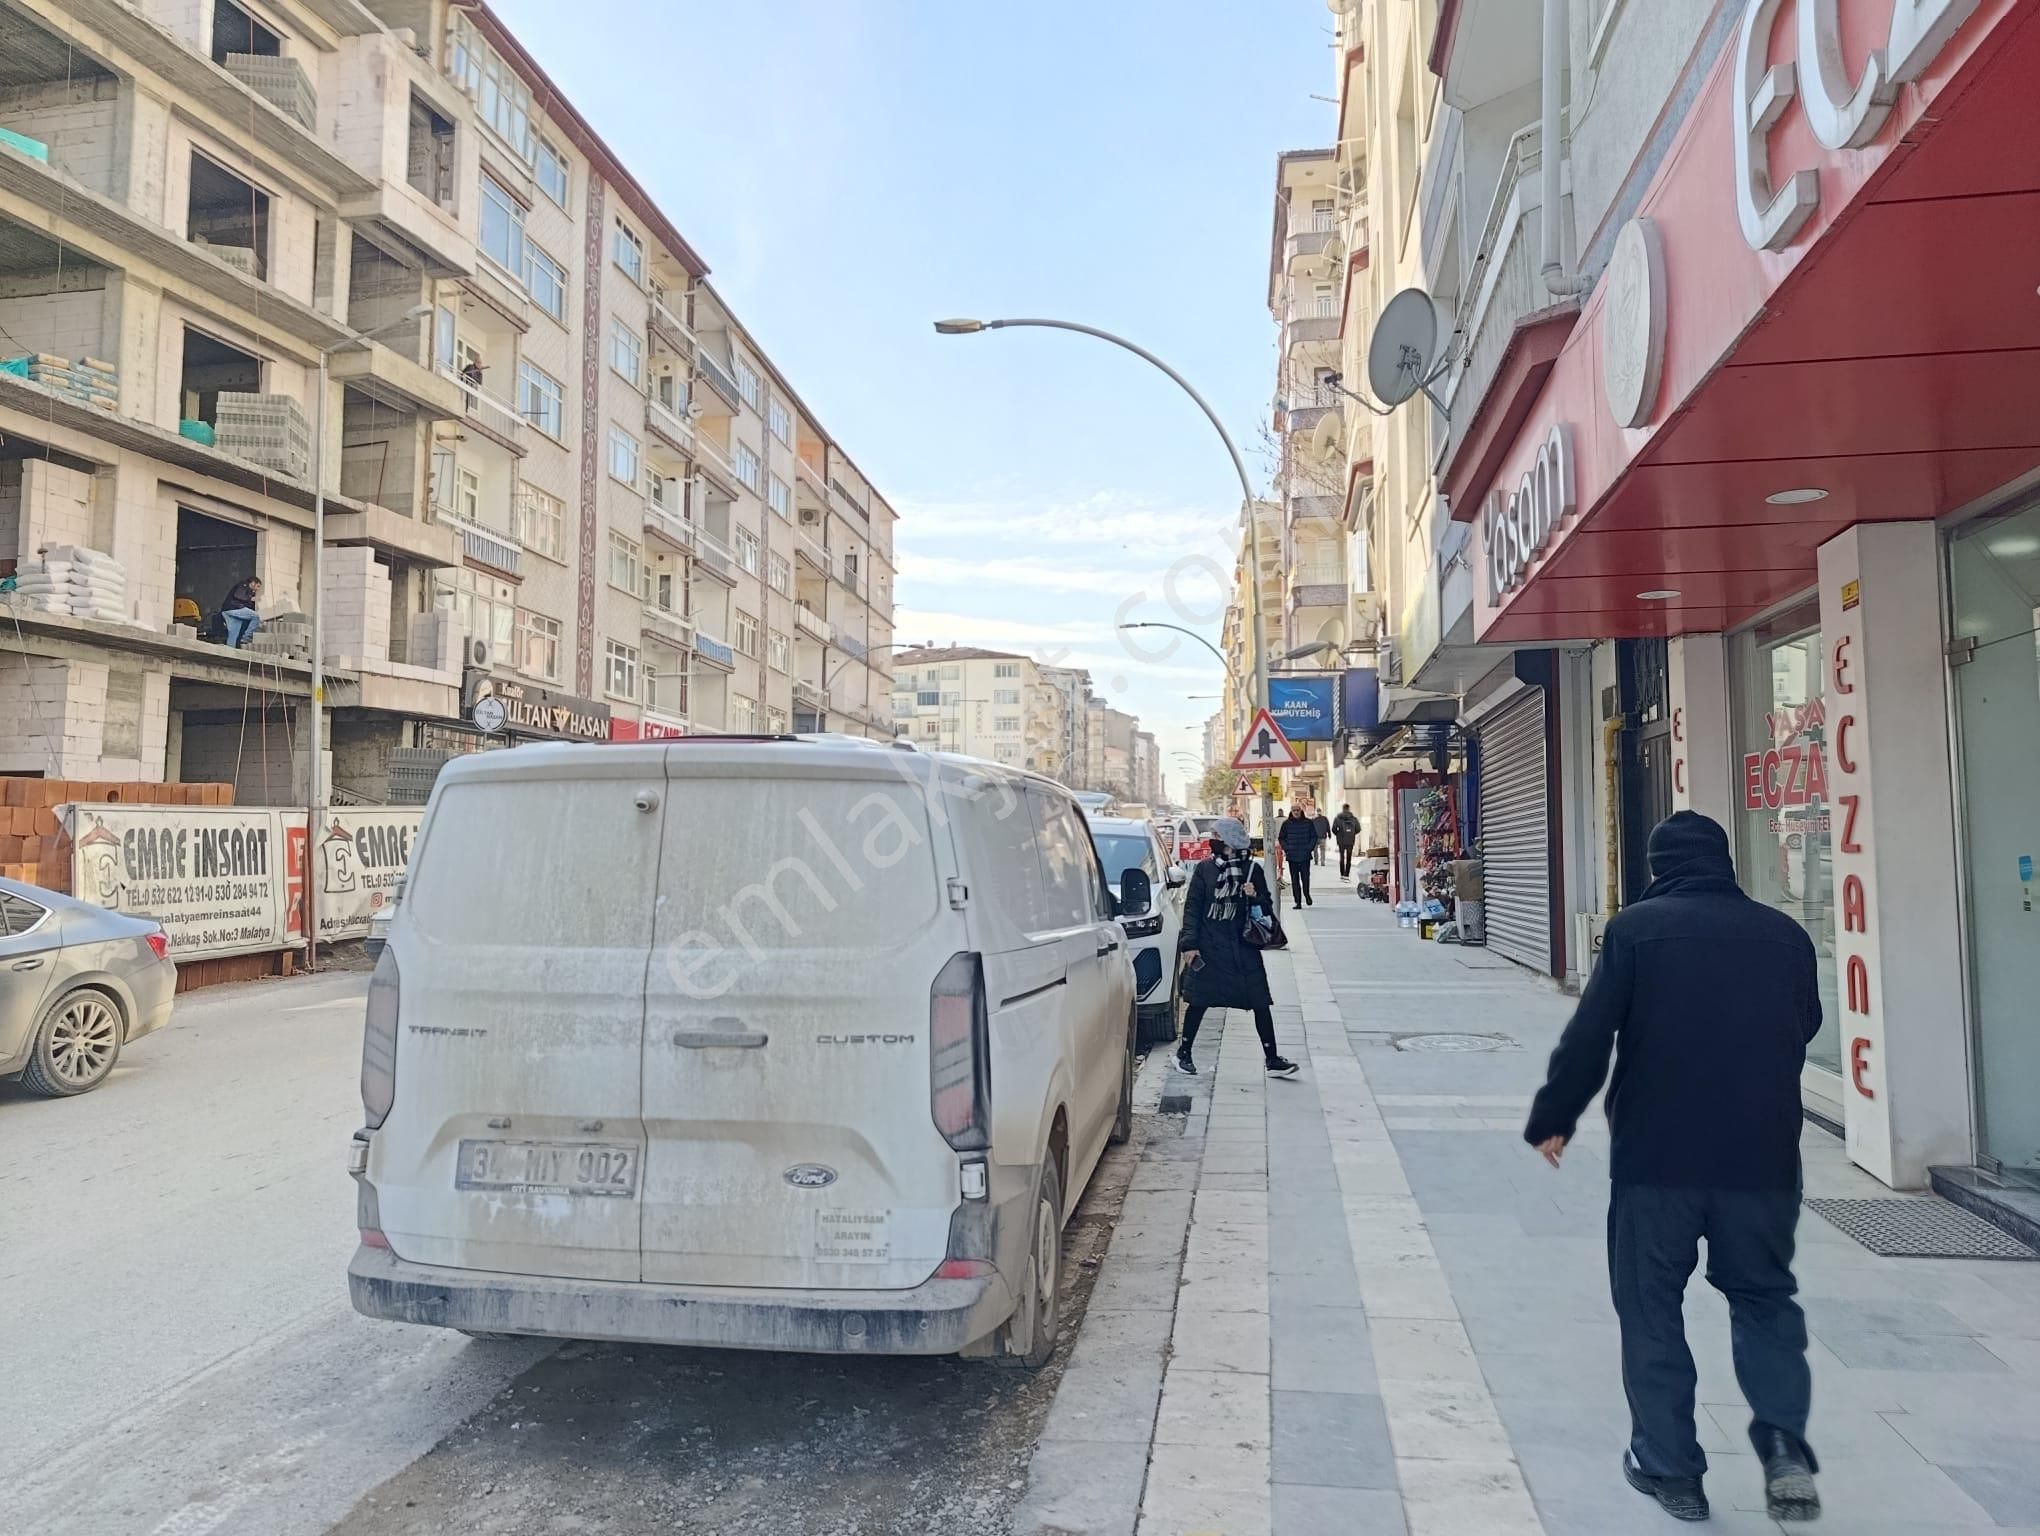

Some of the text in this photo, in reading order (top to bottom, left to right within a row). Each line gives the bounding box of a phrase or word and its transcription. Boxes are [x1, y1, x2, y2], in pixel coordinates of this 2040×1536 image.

[1284, 700, 1308, 709] KAAN
[570, 712, 609, 739] HASAN
[123, 827, 188, 881] EMRE
[151, 886, 165, 905] 532
[167, 886, 183, 904] 622
[215, 884, 231, 901] 530
[233, 883, 248, 900] 284
[240, 926, 271, 942] Malatya
[816, 1034, 915, 1045] CUSTOM
[577, 1151, 629, 1185] 902
[792, 1167, 827, 1186] Ford
